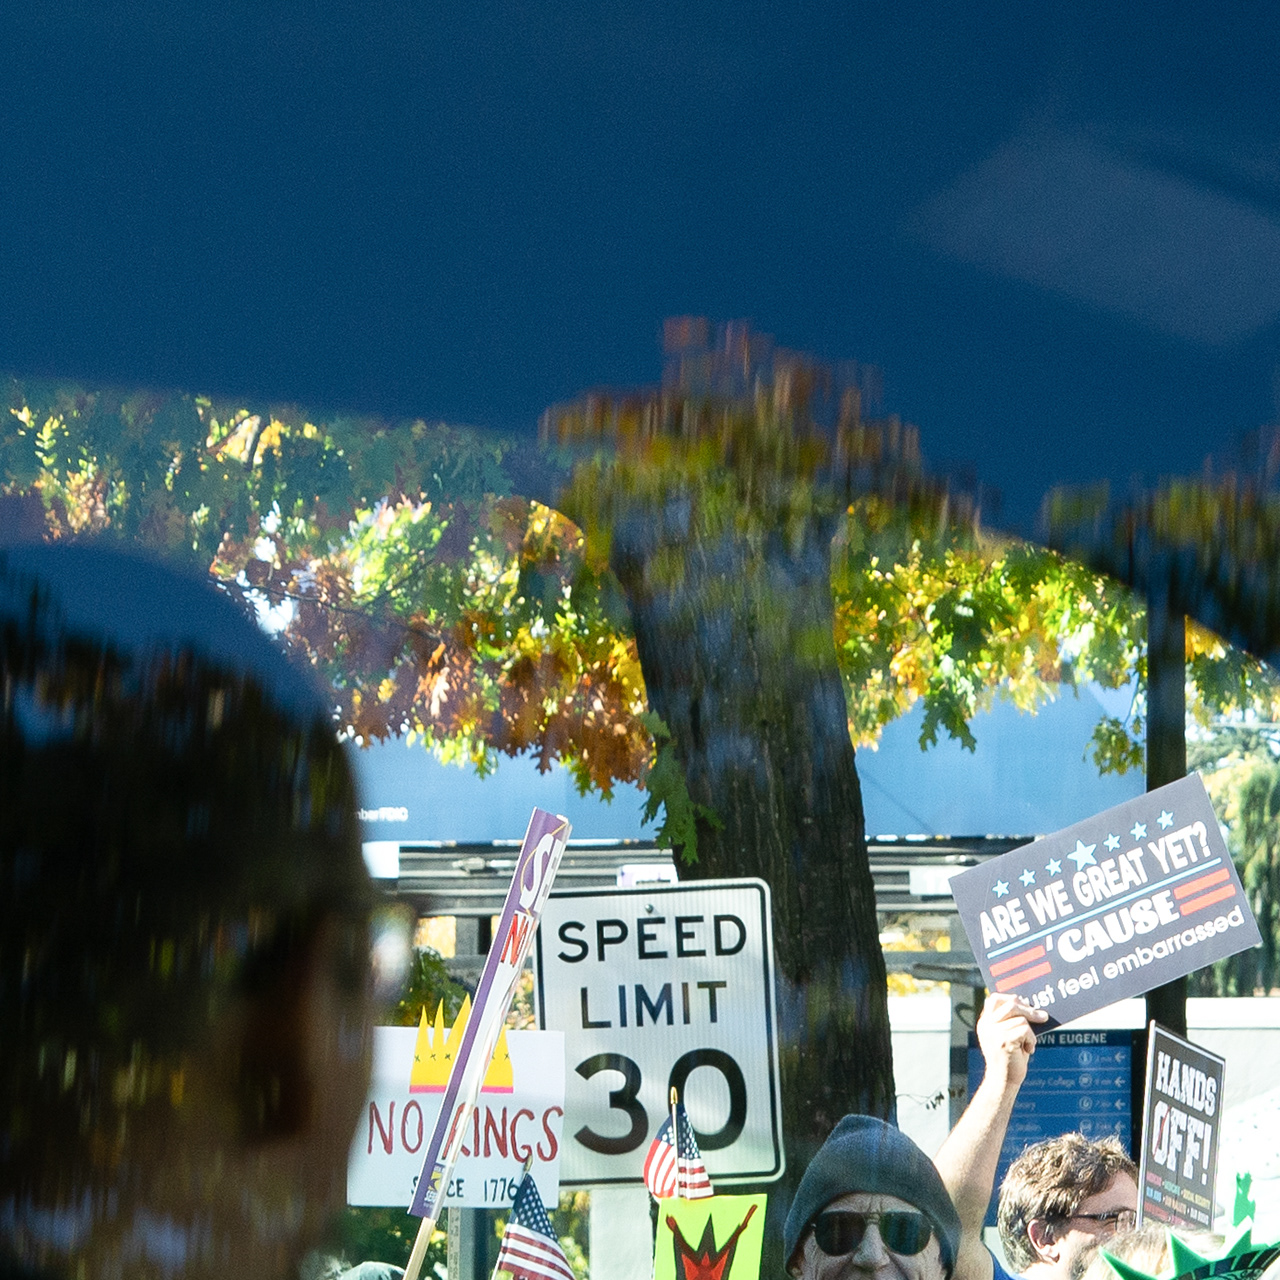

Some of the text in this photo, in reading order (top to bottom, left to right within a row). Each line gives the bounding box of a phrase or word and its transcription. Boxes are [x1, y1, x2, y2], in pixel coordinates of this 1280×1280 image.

[979, 820, 1212, 949] ARE WE GREAT YET?
[557, 914, 747, 963] SPEED
[1021, 904, 1245, 1011] ust feel embarrassed
[1045, 889, 1181, 964] 'CAUSE
[580, 980, 727, 1029] LIMIT
[1059, 1033, 1107, 1045] EUGENE
[573, 1048, 748, 1155] 30
[1155, 1050, 1218, 1117] HANDS
[367, 1099, 564, 1163] NO INGS
[1152, 1100, 1212, 1186] OFF!
[483, 1177, 519, 1202] 1776
